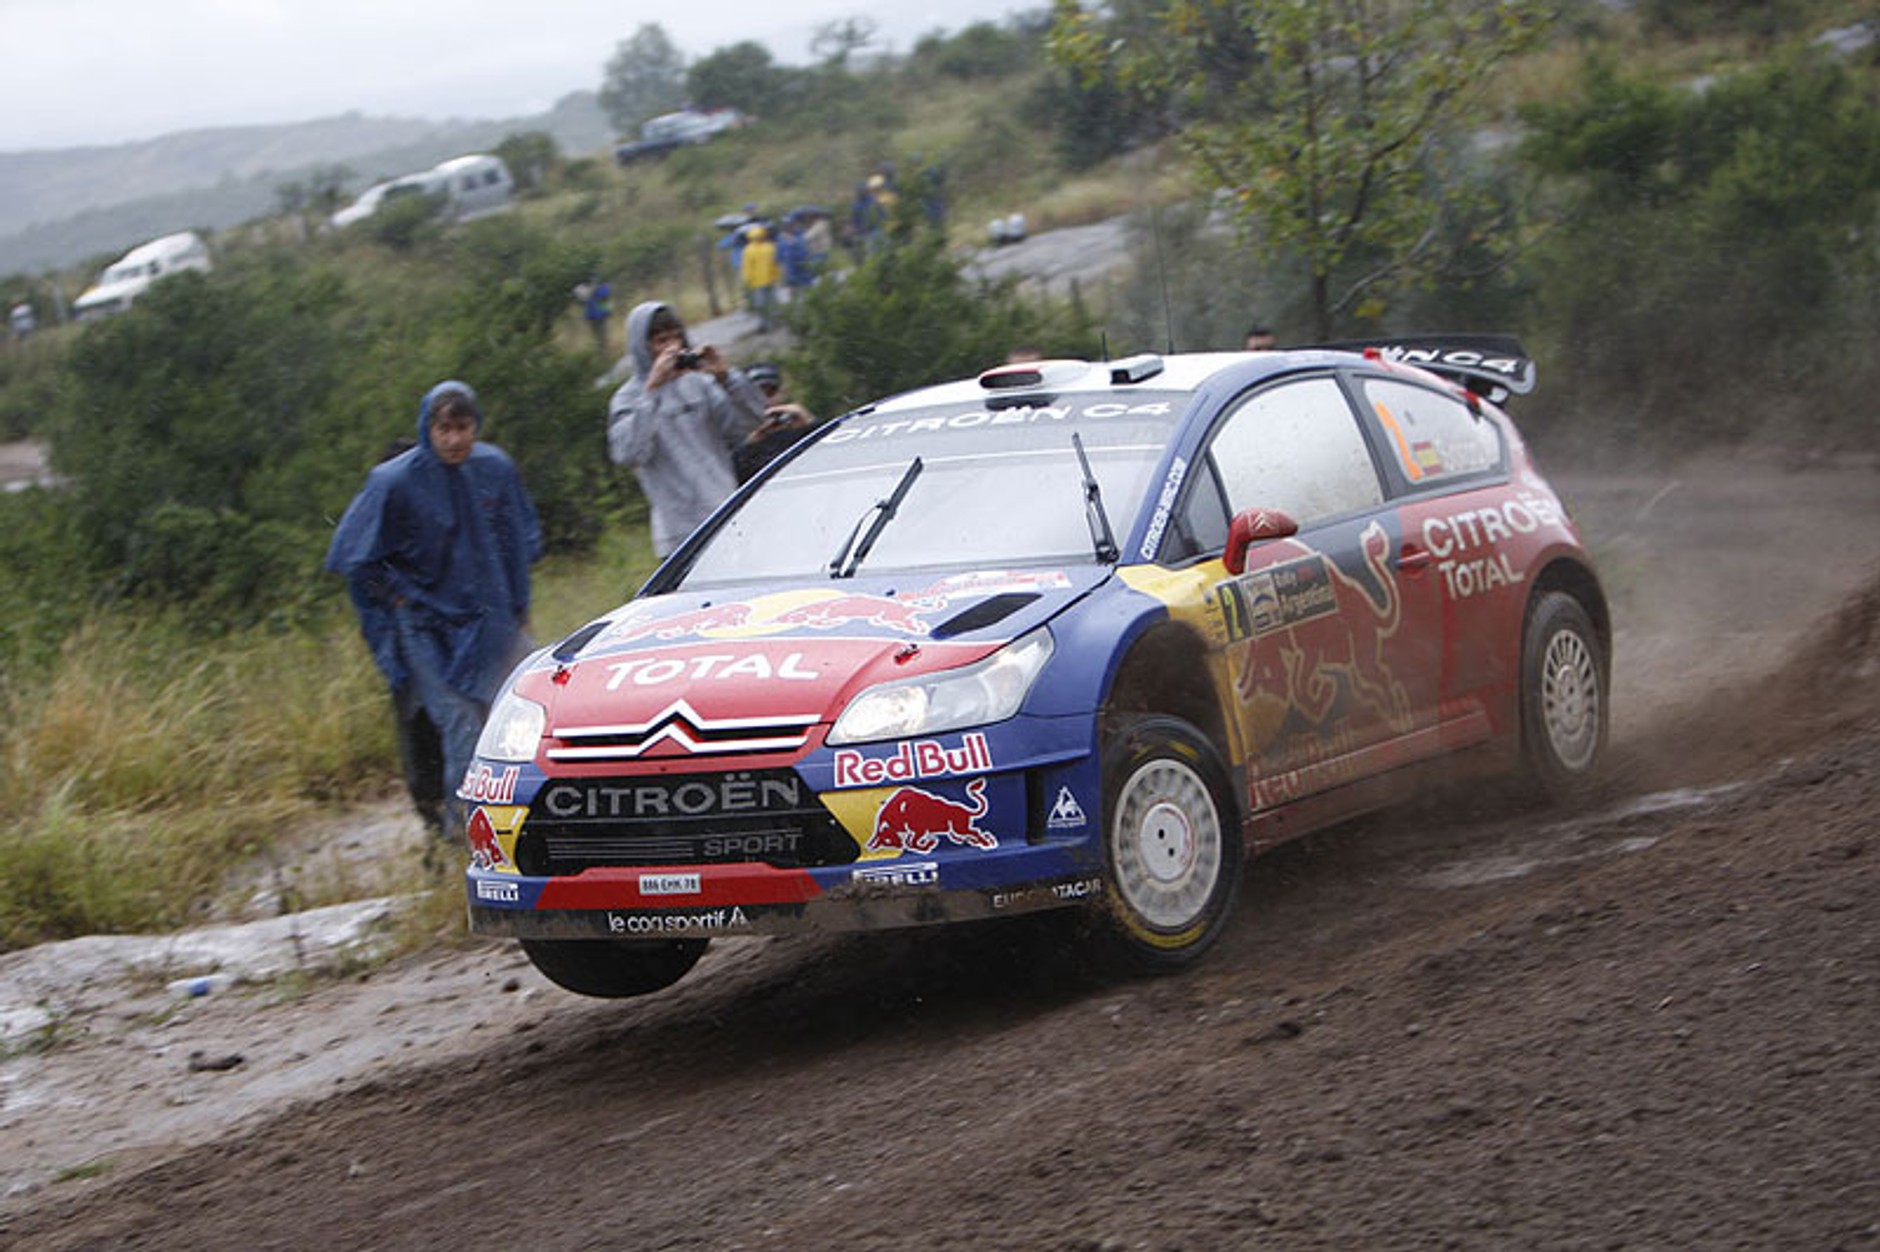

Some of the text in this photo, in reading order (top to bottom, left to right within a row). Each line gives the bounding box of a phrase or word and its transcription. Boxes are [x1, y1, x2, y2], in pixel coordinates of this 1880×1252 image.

[1442, 351, 1518, 373] C4
[1083, 401, 1172, 419] C4
[1438, 552, 1525, 600] TOTAL
[605, 652, 819, 692] TOTAL
[835, 732, 992, 786] Red Bull
[545, 772, 800, 817] CITROËN
[703, 833, 801, 857] SPORT
[607, 910, 626, 933] le
